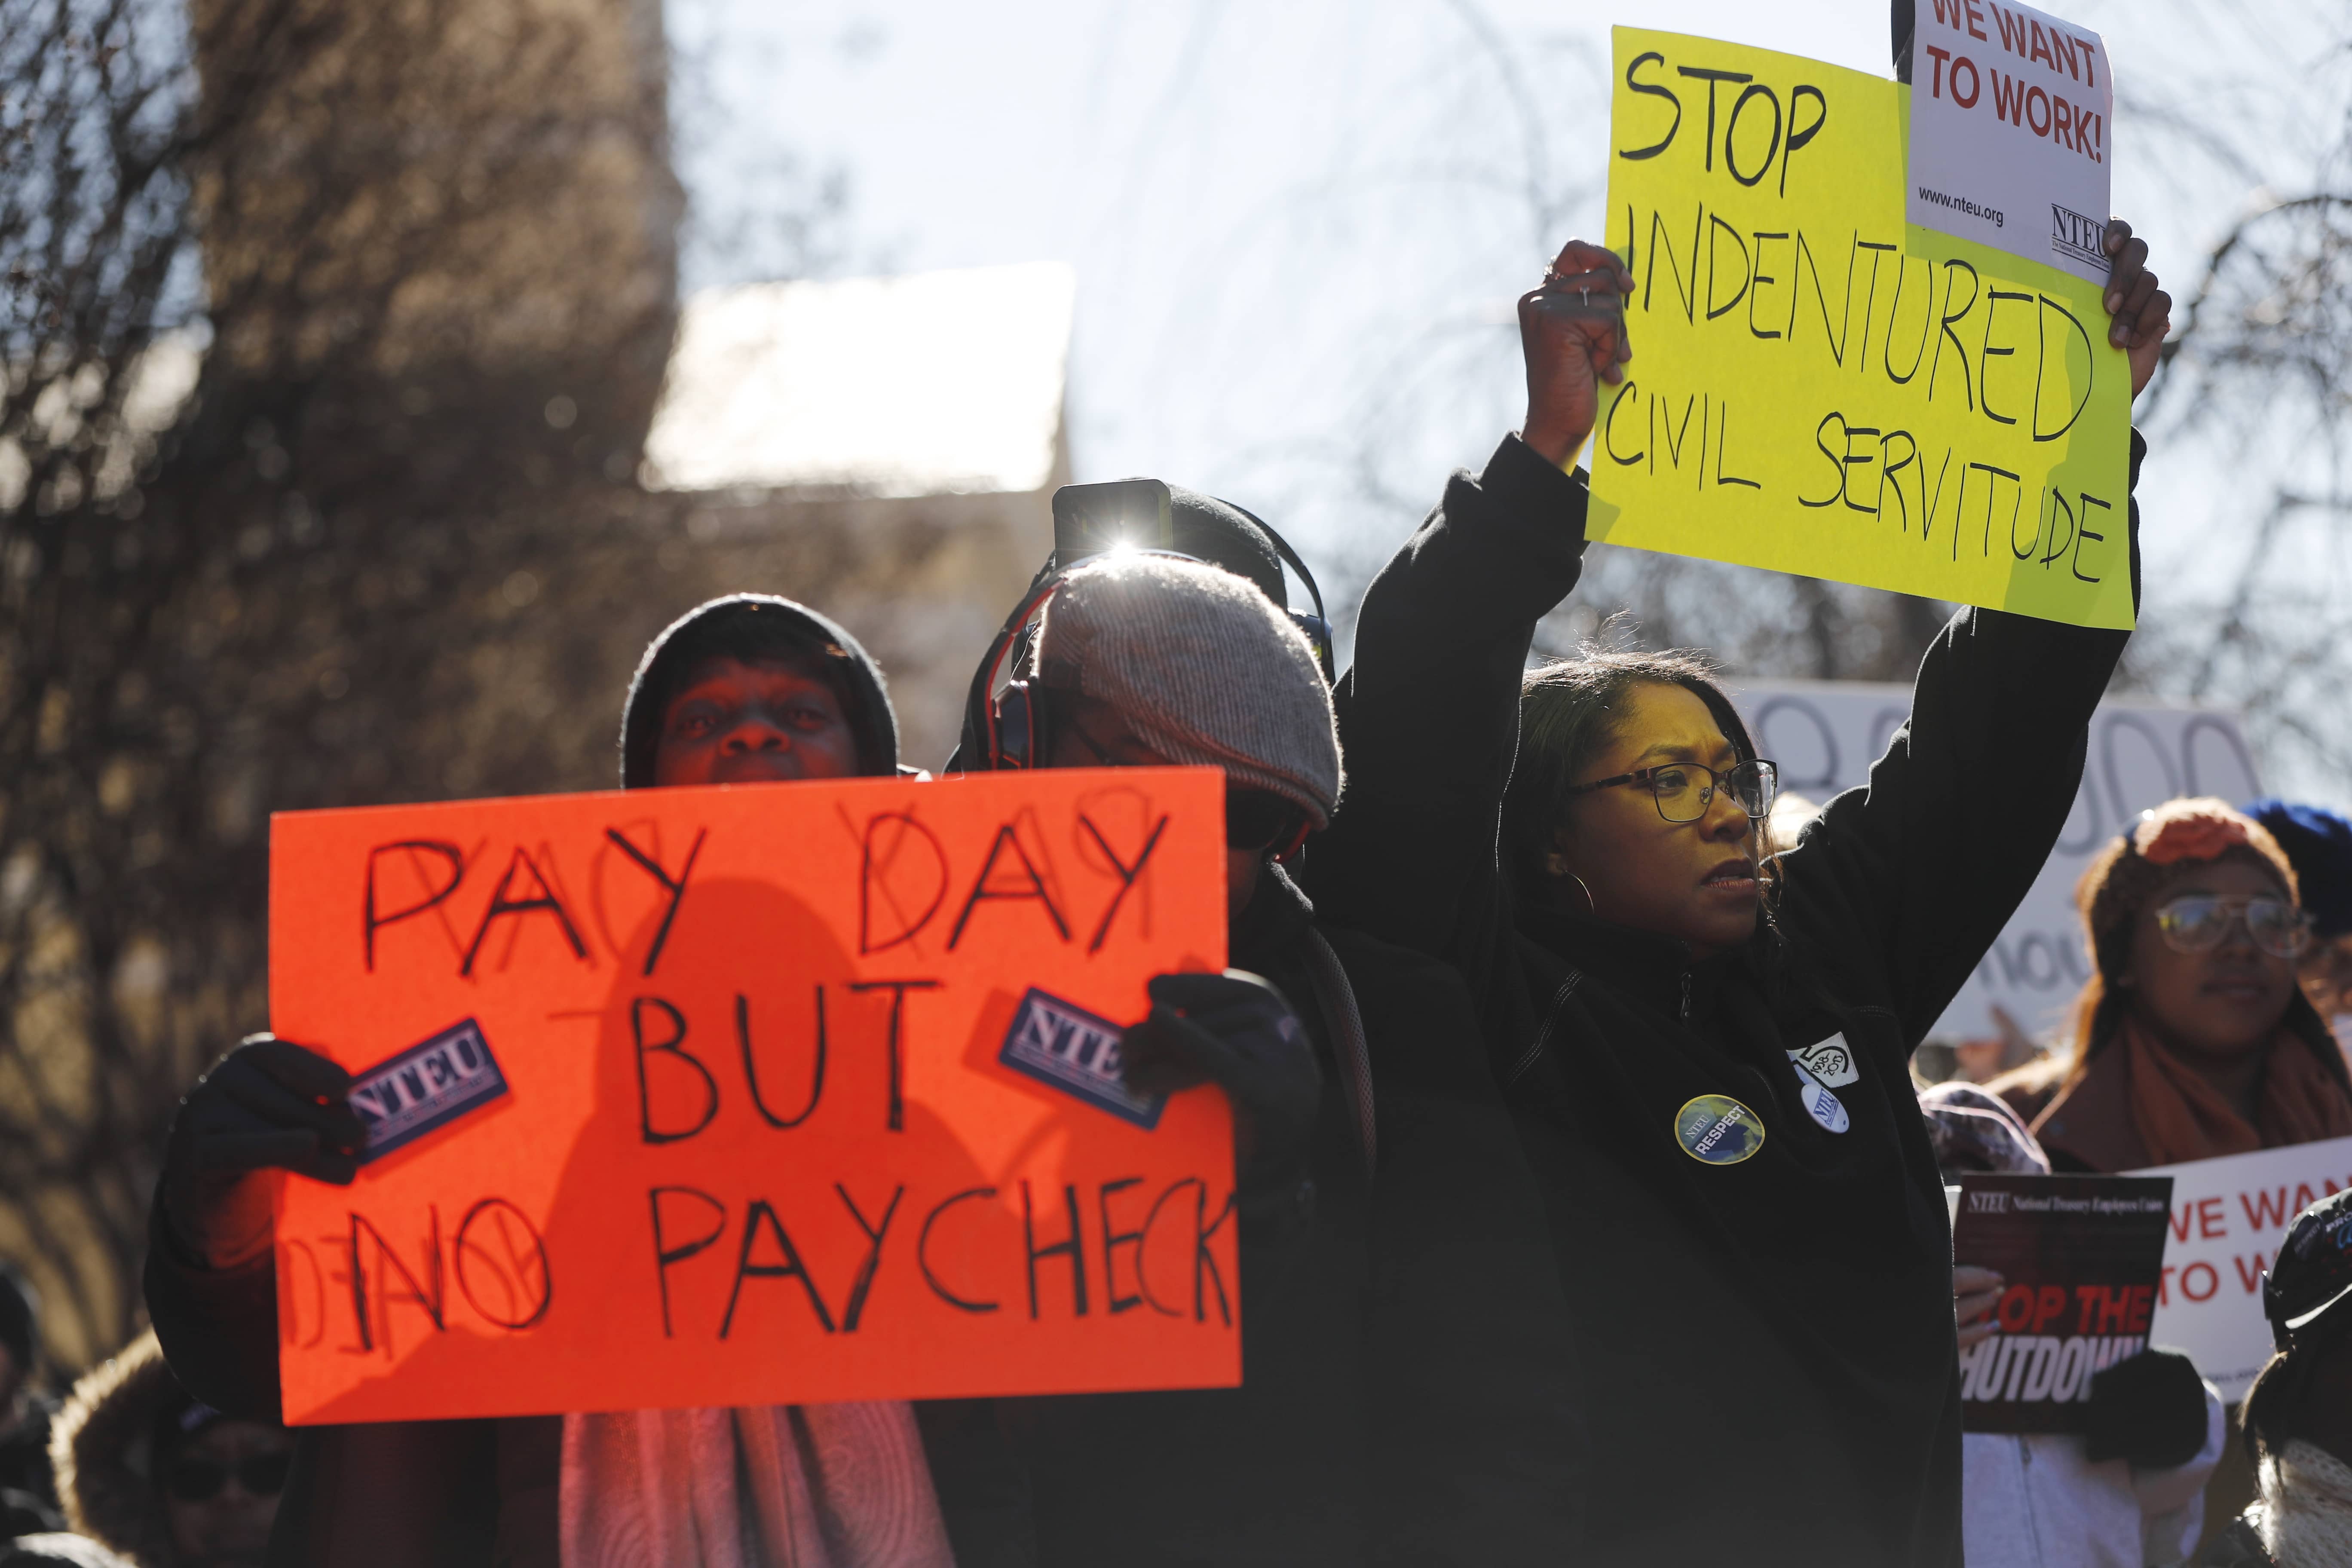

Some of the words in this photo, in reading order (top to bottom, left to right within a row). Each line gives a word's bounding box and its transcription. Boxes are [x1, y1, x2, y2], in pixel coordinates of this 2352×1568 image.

[1990, 3, 2095, 88] WANT
[1619, 51, 1826, 199] STOP
[1927, 45, 1980, 109] TO
[1990, 68, 2102, 163] WORK!
[1919, 187, 2004, 227] www.nteu.org
[2052, 206, 2106, 257] NTEU
[1623, 202, 2093, 442] INDENTURED
[1605, 381, 1761, 492] CIVIL
[1798, 411, 2111, 583] SERVITUDE
[360, 824, 709, 977] PAY
[858, 811, 1171, 959] DAY
[349, 1032, 487, 1122] NTEU
[629, 980, 940, 1145] BUT
[1016, 1000, 1123, 1082] NTE
[1685, 1115, 1711, 1139] NTEU
[1694, 1105, 1746, 1155] RESPECT
[1967, 1191, 2011, 1213] NTEU
[346, 1197, 552, 1353] NO
[648, 1176, 1238, 1342] PAYCHECK
[1994, 1283, 2067, 1334] OP
[2075, 1284, 2155, 1334] THE
[1961, 1334, 2146, 1404] HUTDOW
